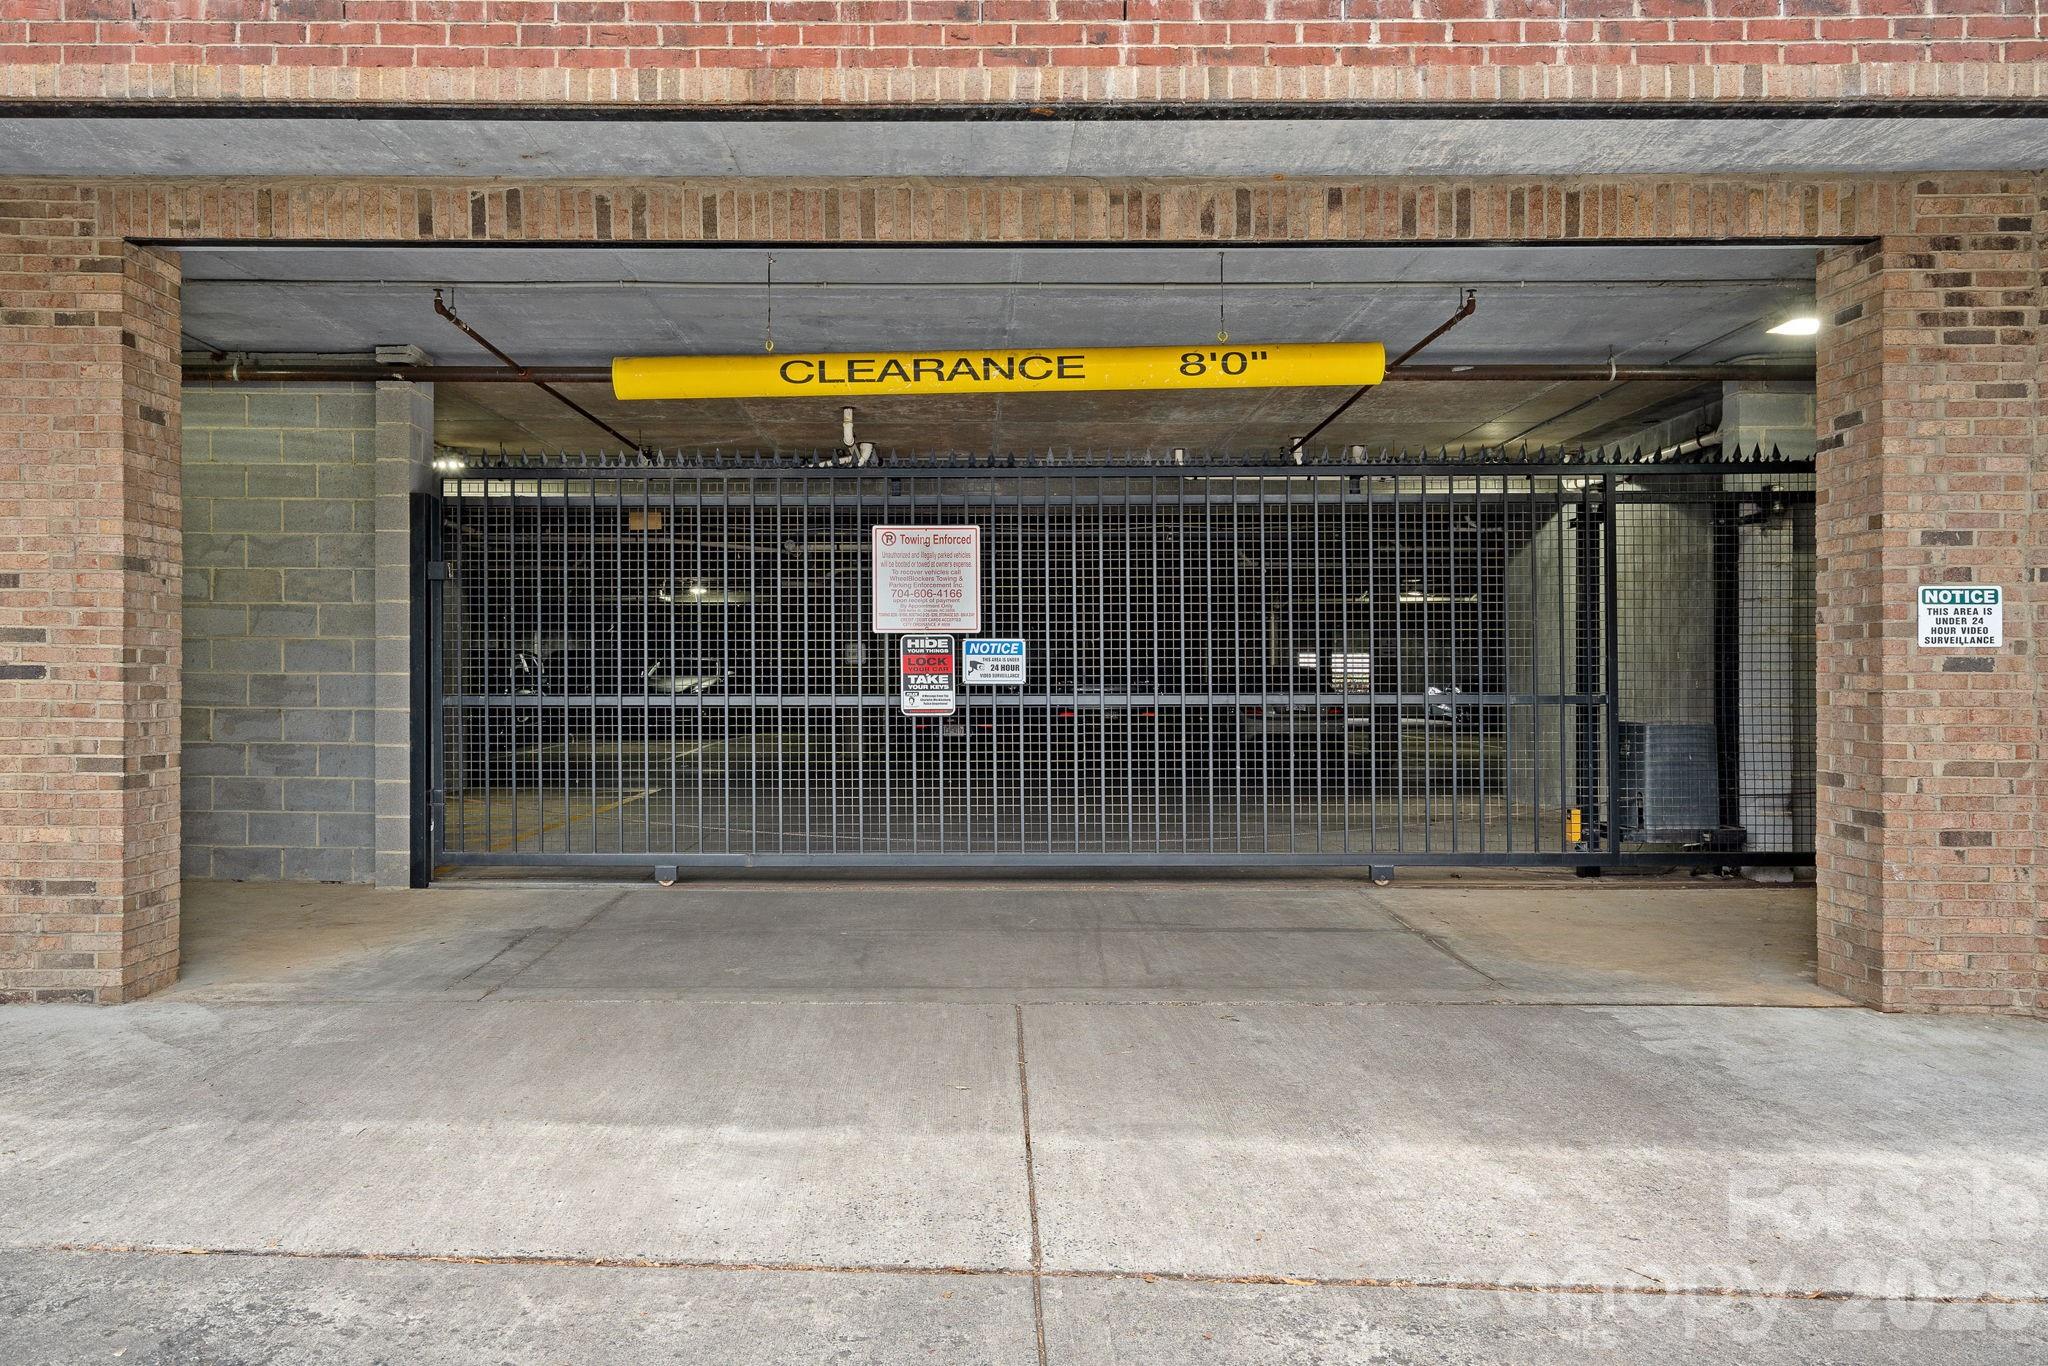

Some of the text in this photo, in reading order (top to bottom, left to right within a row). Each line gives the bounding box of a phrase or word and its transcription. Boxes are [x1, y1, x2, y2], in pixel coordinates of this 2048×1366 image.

[780, 350, 1269, 384] CLEARANCE 8'0"
[900, 534, 972, 547] Towing Enforced
[937, 552, 952, 560] parked
[891, 589, 962, 598] 704-606-4166
[1925, 590, 1996, 603] NOTICE
[907, 639, 948, 648] HIDE
[969, 643, 1019, 654] NOTICE
[908, 658, 948, 666] LOCK
[908, 675, 949, 684] TAKE
